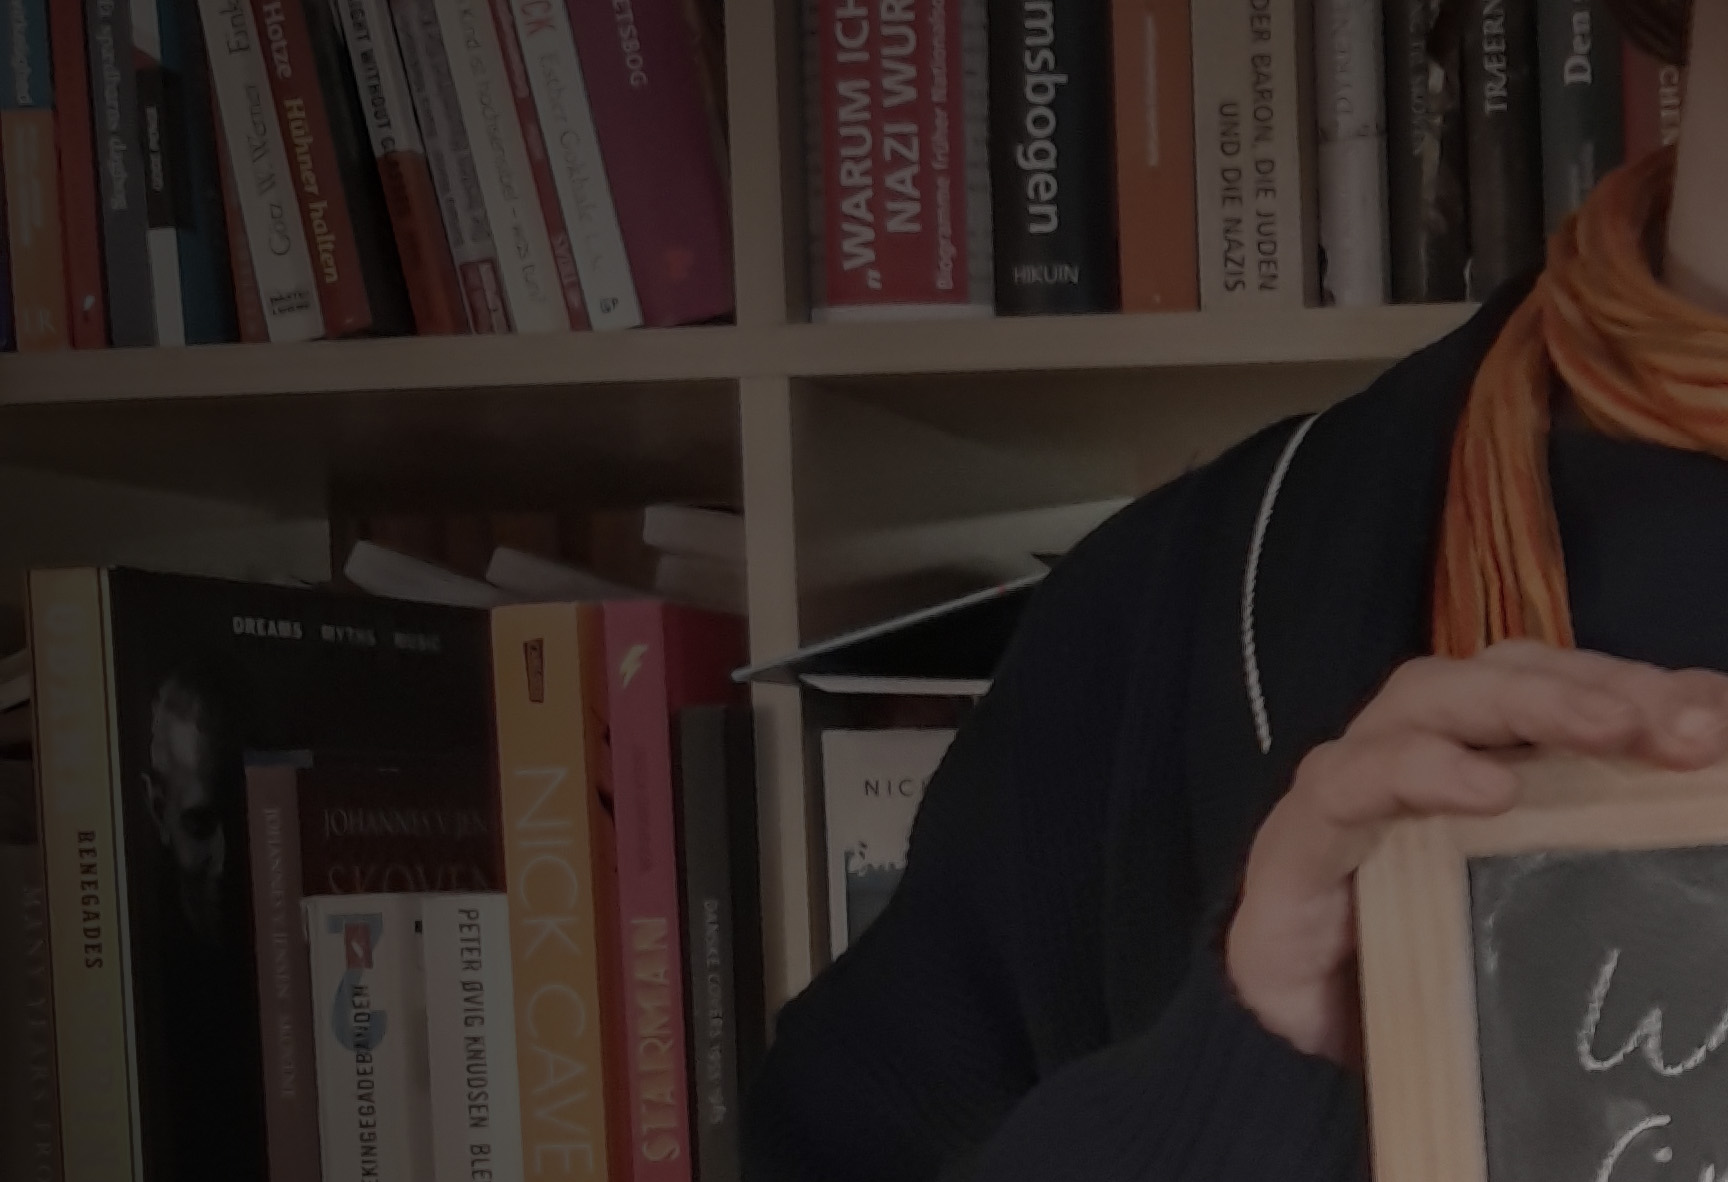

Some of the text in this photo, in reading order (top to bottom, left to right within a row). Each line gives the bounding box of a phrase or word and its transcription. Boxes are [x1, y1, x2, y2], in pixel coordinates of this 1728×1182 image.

[881, 0, 924, 234] NAZI WUR
[1015, 0, 1070, 235] msbogen
[1564, 9, 1593, 87] Den
[263, 2, 292, 80] Hotze
[308, 199, 340, 285] halten
[1218, 101, 1247, 294] UND DIE NAZIS
[1254, 158, 1277, 200] DIE
[1256, 210, 1280, 292] JUDEN
[76, 829, 104, 971] RENEGADES
[456, 908, 482, 973] PETER
[512, 764, 595, 1175] NICK CAVE
[460, 978, 486, 1027] ØVIG
[630, 915, 681, 1163] STARMAN
[464, 1035, 489, 1129] KNUDSEN
